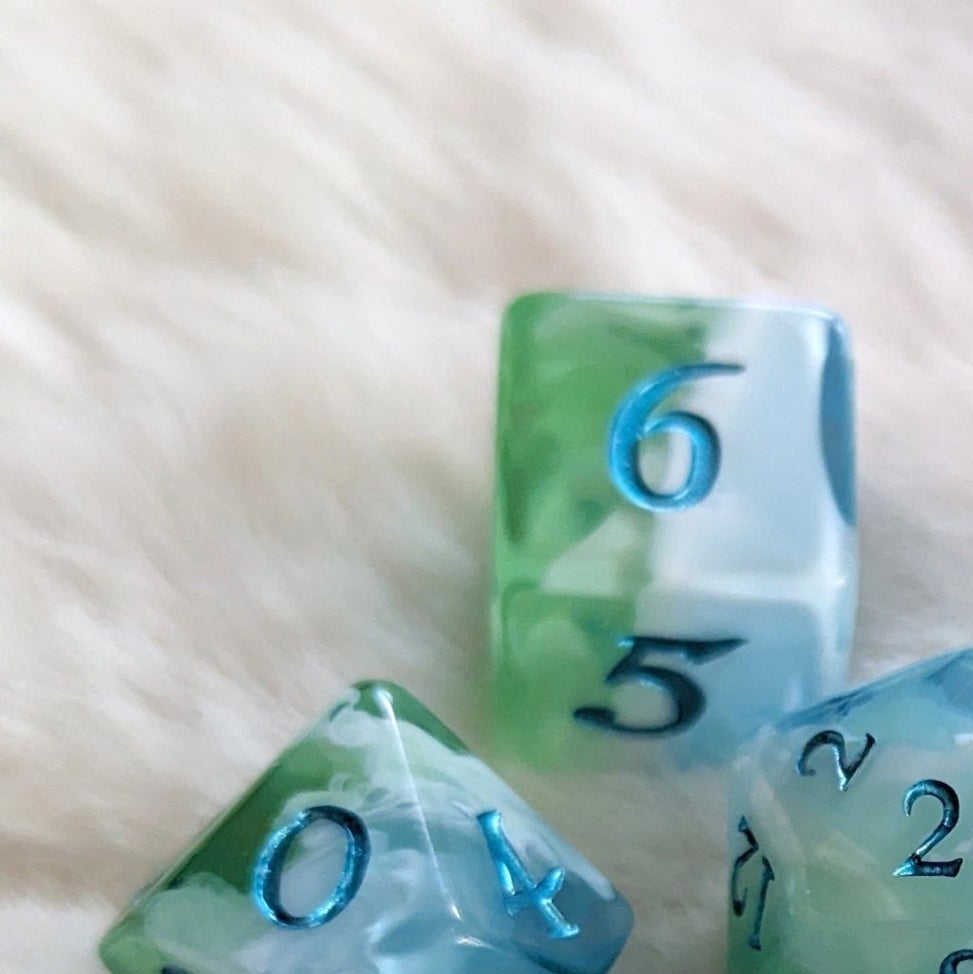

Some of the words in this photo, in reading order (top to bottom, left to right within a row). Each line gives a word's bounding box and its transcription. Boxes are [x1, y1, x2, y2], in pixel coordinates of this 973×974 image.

[606, 362, 746, 513] 6
[572, 634, 749, 739] 5
[476, 809, 580, 939] 4
